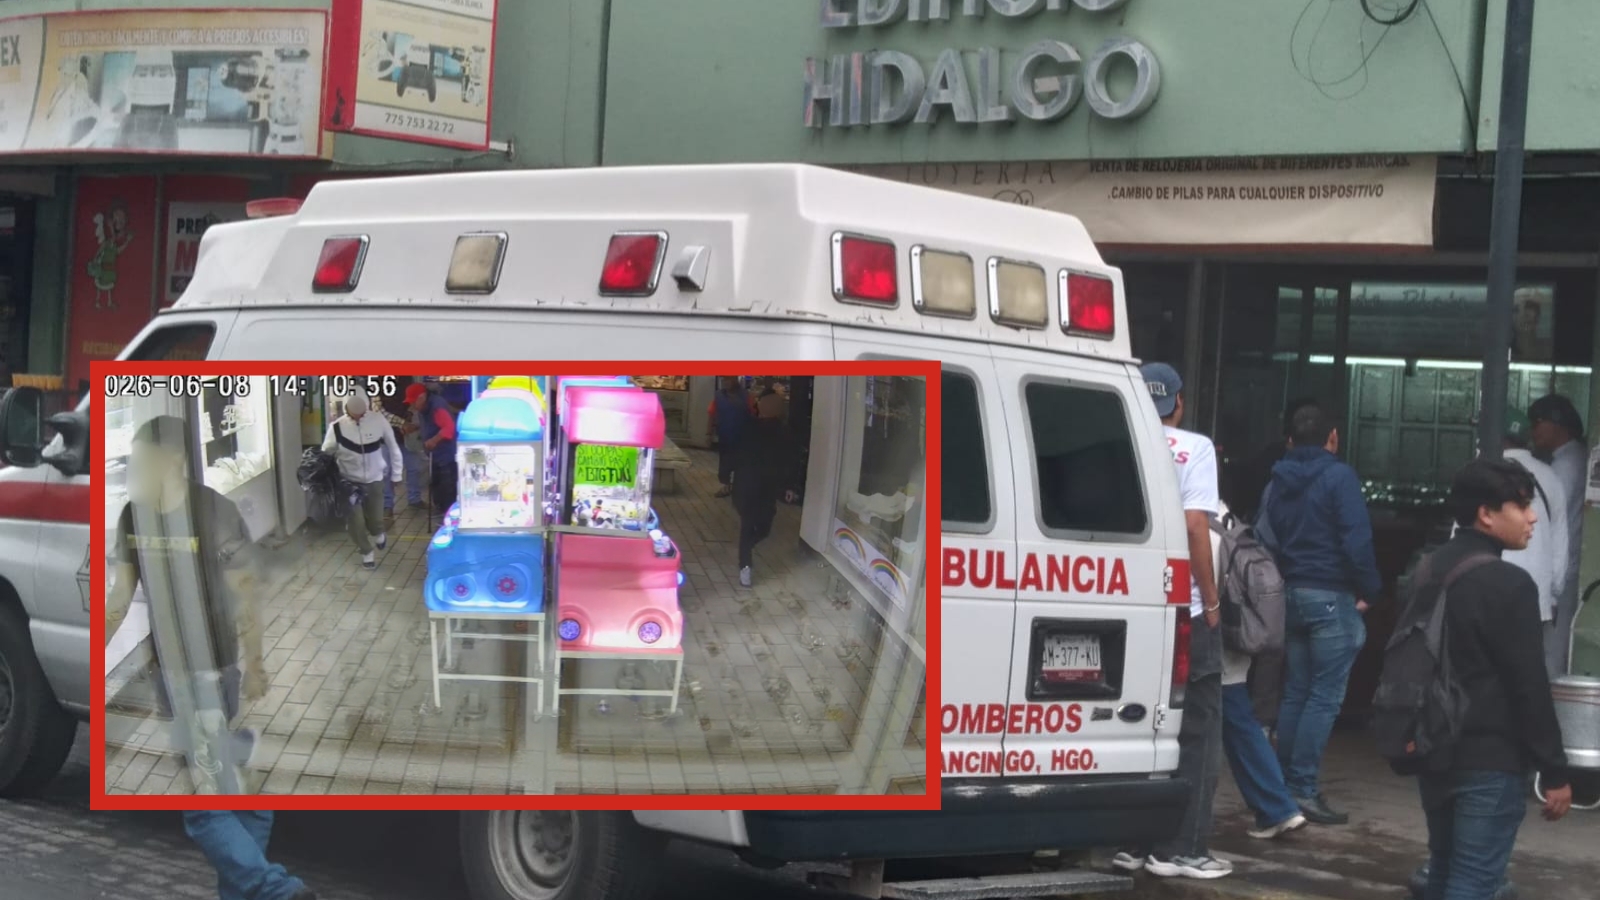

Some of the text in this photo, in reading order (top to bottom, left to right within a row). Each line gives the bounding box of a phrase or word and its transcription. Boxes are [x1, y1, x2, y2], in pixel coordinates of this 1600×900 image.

[804, 37, 1161, 128] HIDALGO
[385, 112, 454, 134] 775 753 22 72
[1090, 159, 1122, 172] VENTA
[1125, 158, 1140, 172] DE
[1156, 186, 1169, 199] DE
[1173, 186, 1204, 199] PILAS
[1207, 186, 1235, 199] PARA
[1239, 186, 1305, 200] CUALQUIER
[942, 547, 1130, 596] BULANCIA
[941, 703, 1083, 734] OMBEROS
[1051, 748, 1098, 771] HGO.
